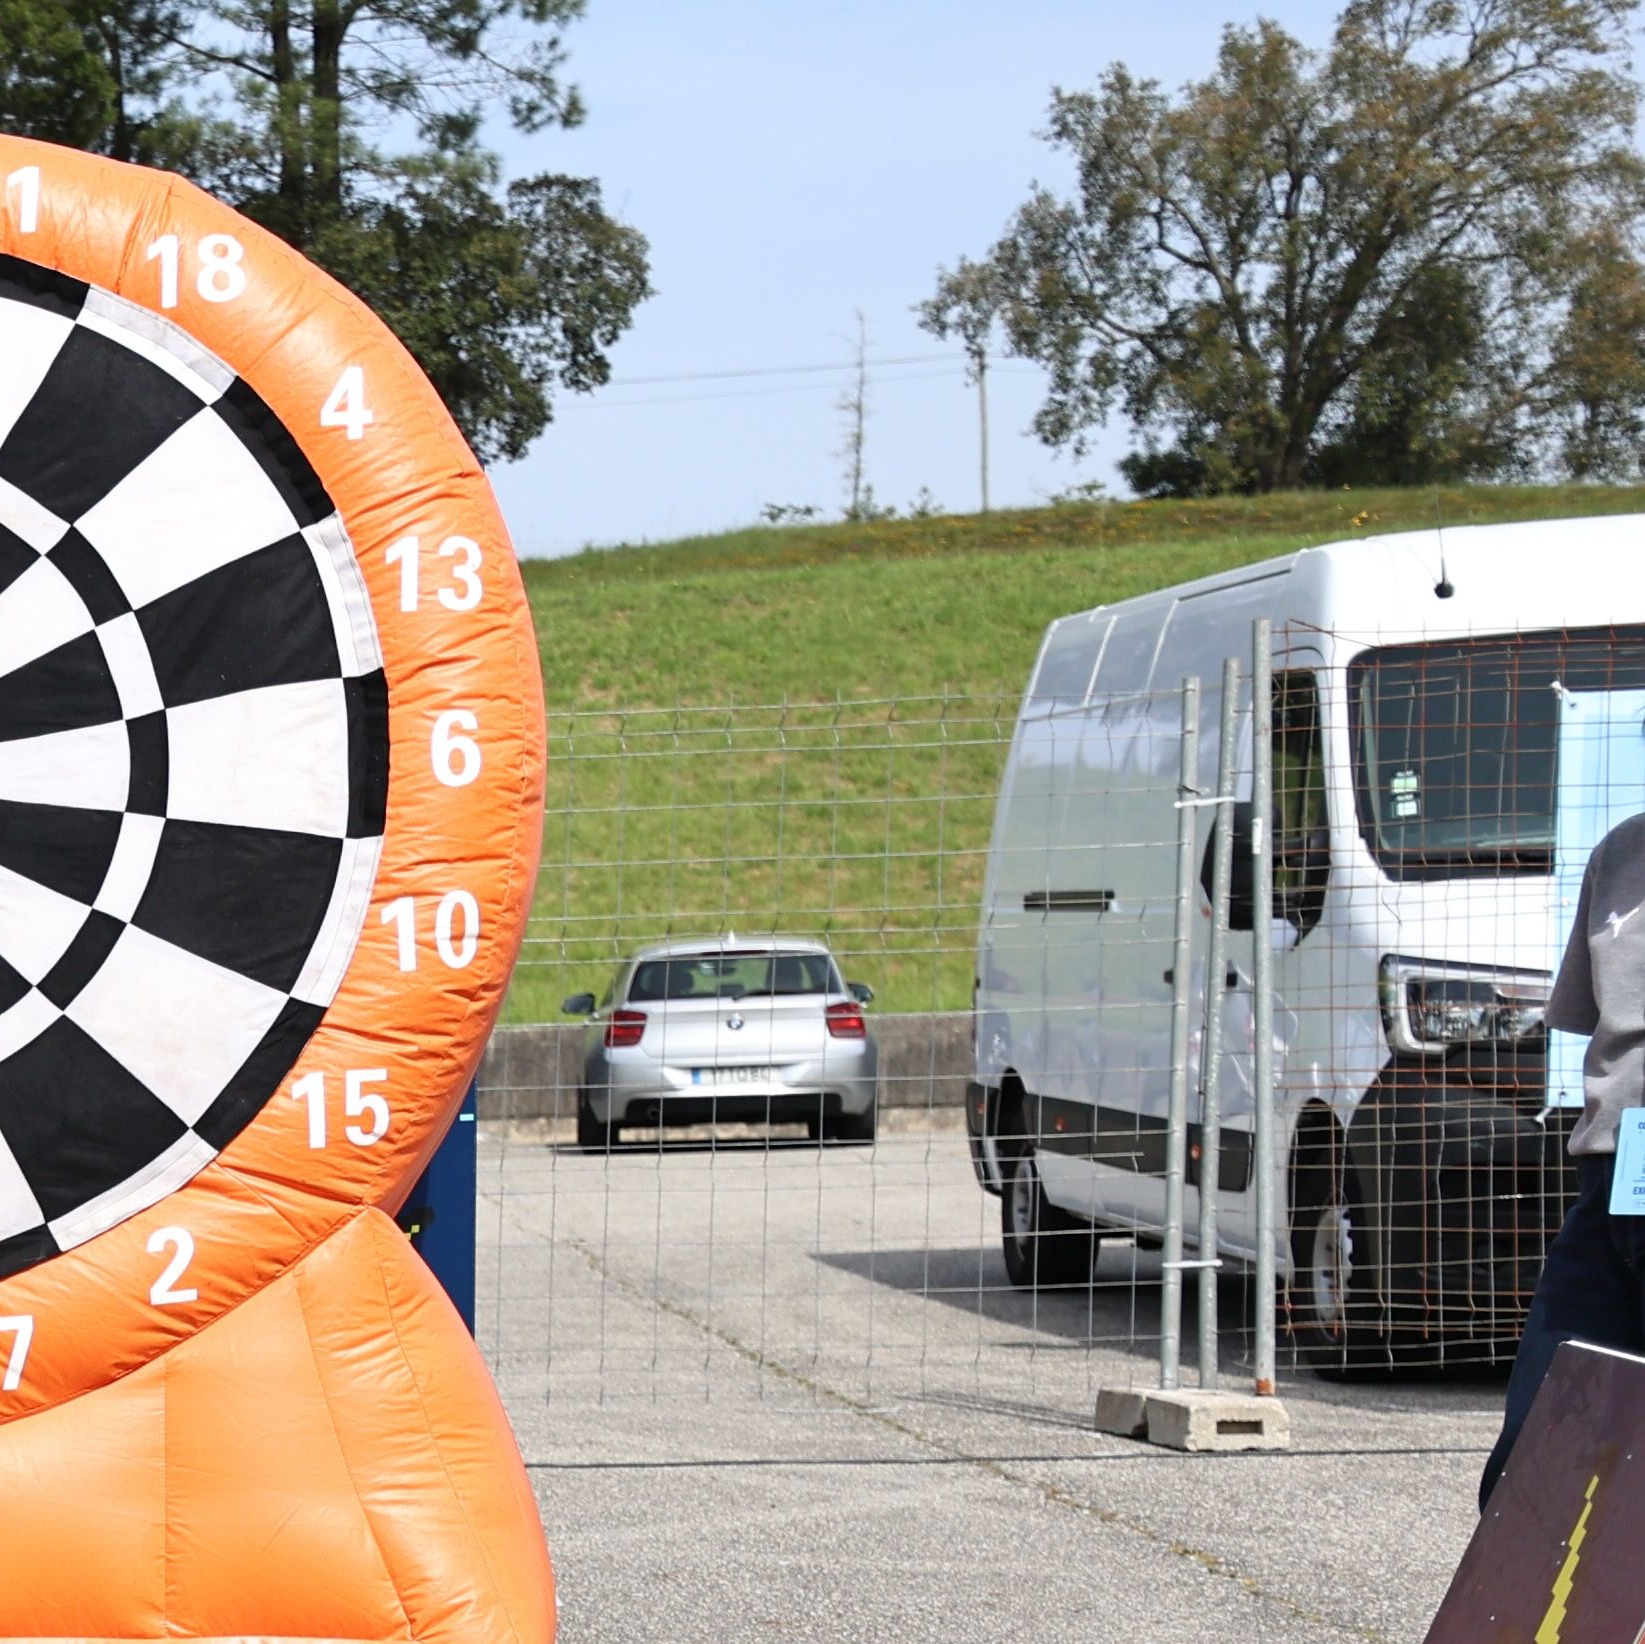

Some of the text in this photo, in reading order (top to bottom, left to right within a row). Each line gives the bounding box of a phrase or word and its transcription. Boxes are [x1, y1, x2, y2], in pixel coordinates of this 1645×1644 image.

[7, 165, 40, 233] 1
[145, 233, 246, 308] 18
[320, 365, 373, 440] 4
[385, 535, 484, 613] 13
[430, 709, 482, 787] 6
[380, 889, 480, 973] 10
[290, 1068, 391, 1149] 15
[145, 1226, 199, 1306] 2
